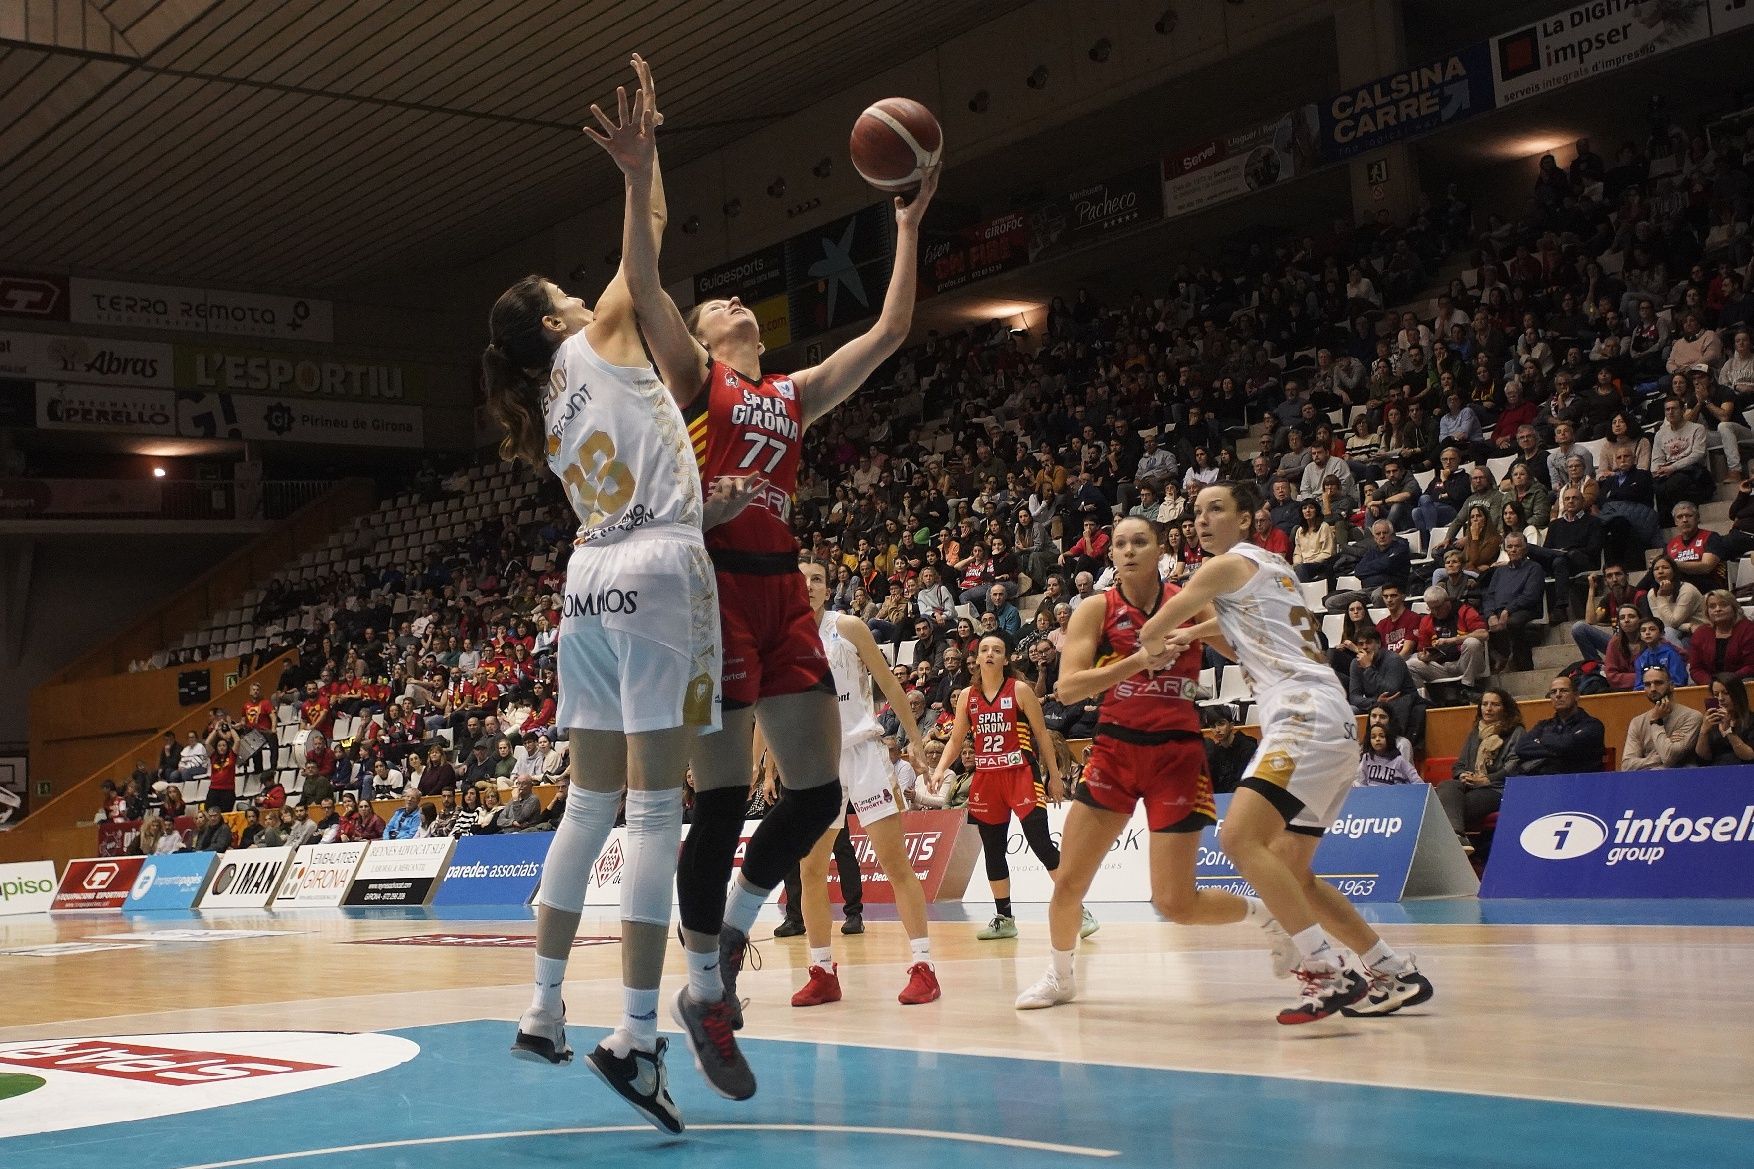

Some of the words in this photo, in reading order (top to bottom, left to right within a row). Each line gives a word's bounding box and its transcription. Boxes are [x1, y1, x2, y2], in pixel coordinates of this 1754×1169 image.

[1544, 20, 1633, 67] impser
[1331, 55, 1467, 121] CALSINA
[1503, 81, 1541, 103] serveis
[1074, 186, 1137, 225] Pacheco
[984, 216, 1024, 240] GIROFOC
[699, 258, 764, 293] Guidesports
[84, 350, 159, 379] Abras
[195, 352, 405, 399] L'ESPORTIU
[743, 389, 788, 416] SPAR
[301, 414, 348, 429] Pirineu
[352, 416, 367, 430] de
[371, 417, 414, 433] Girona
[731, 404, 799, 443] GIRONA
[738, 431, 787, 474] 77
[978, 711, 1005, 725] SPAR
[982, 734, 1006, 754] 22
[1323, 813, 1402, 839] eigrup
[312, 850, 360, 866] EMBALATGES
[1605, 845, 1665, 866] group
[229, 861, 283, 896] IMAN
[302, 867, 350, 890] GIRONA
[444, 861, 489, 882] paredes
[489, 859, 539, 878] associats
[0, 876, 54, 901] piso
[1336, 879, 1376, 897] 1963
